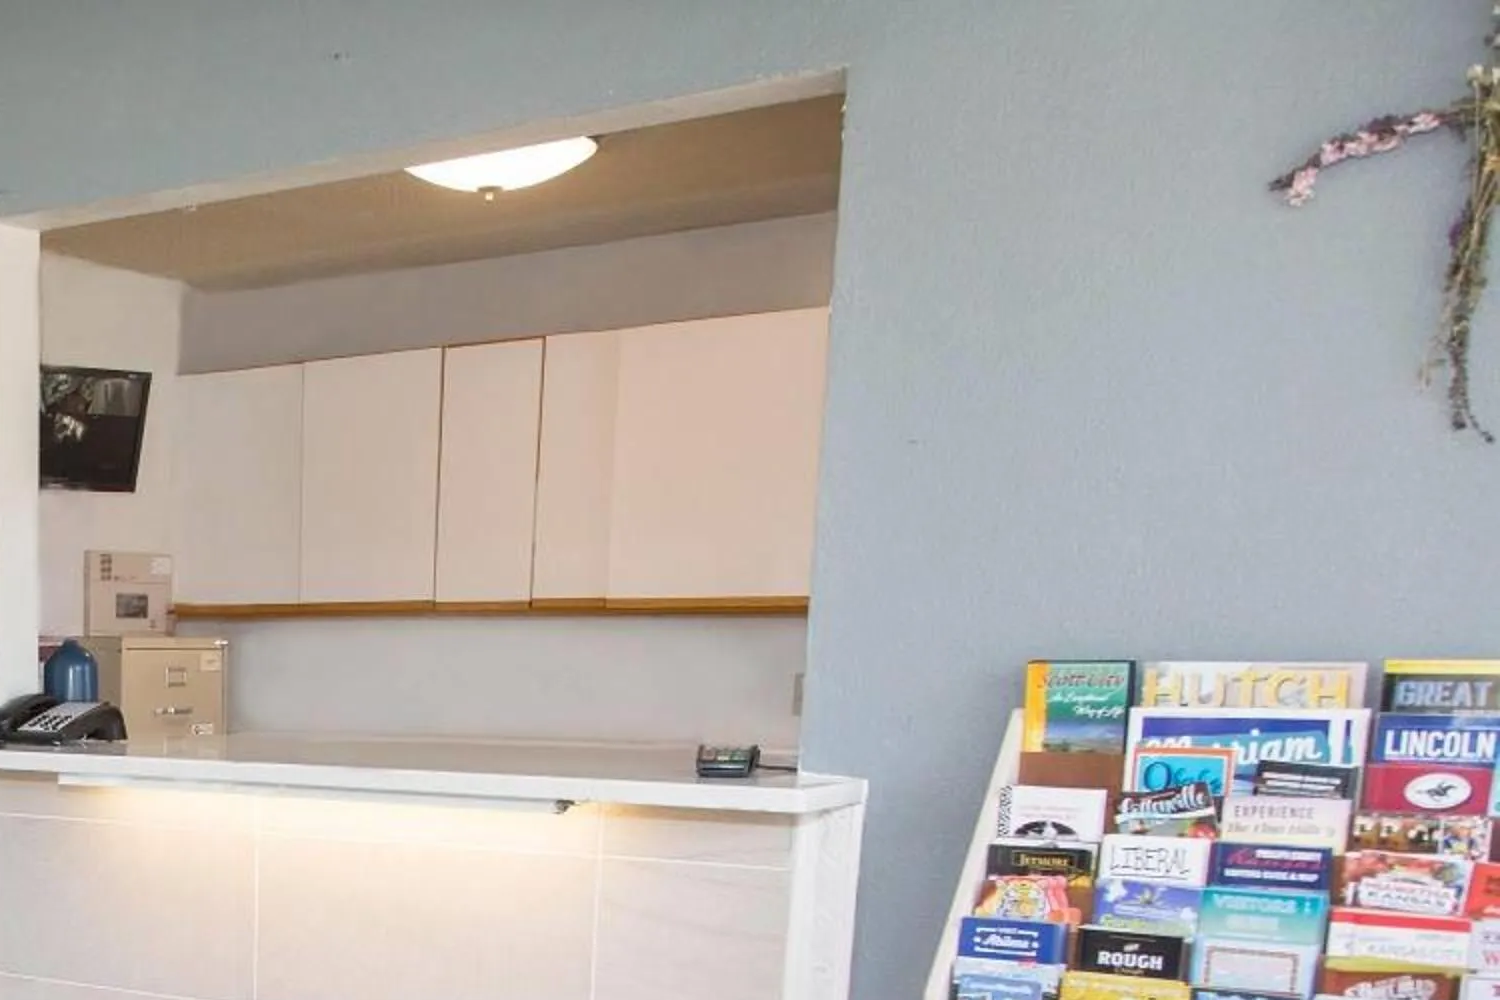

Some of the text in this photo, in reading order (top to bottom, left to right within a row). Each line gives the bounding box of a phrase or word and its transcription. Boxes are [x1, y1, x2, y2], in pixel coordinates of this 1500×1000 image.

[1143, 667, 1352, 708] HUTCH
[1394, 680, 1493, 708] GREAT
[1384, 728, 1497, 760] LINCOLN
[1234, 804, 1315, 819] EXPERIENCE
[1110, 846, 1190, 876] LIBERAL
[1096, 950, 1164, 971] ROUGH
